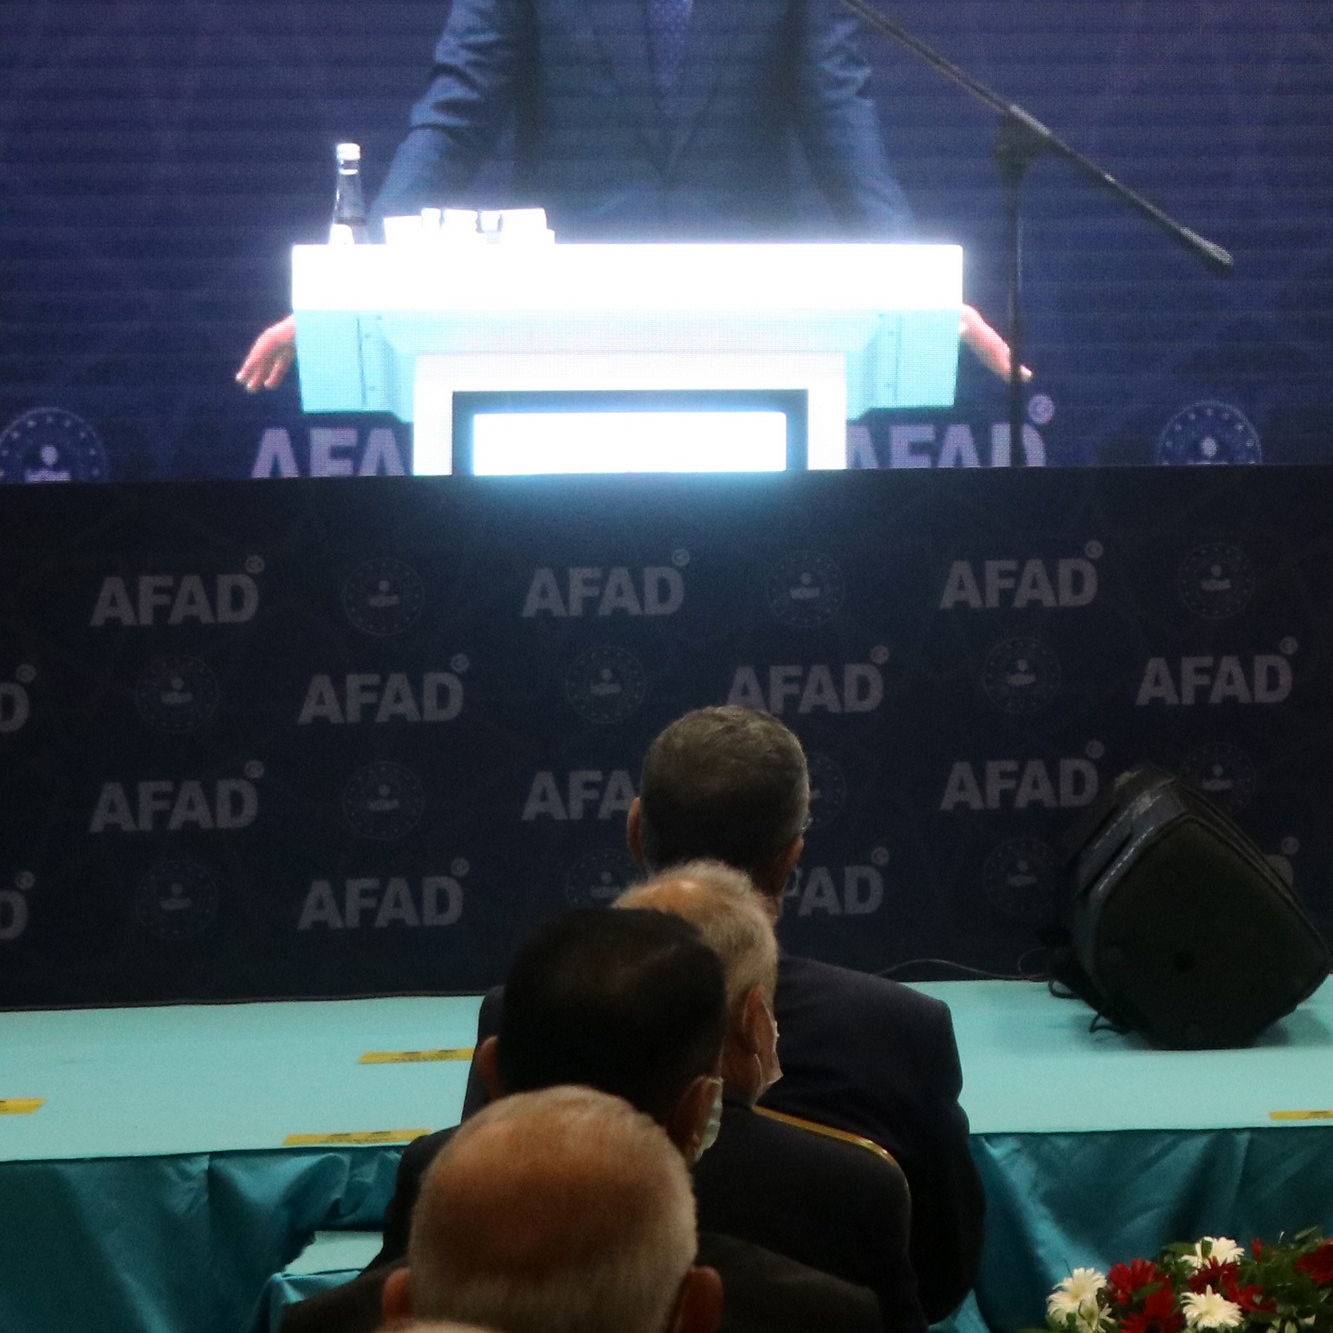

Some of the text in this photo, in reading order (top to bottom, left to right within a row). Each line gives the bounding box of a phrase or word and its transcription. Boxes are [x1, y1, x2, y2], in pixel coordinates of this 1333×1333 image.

[250, 427, 405, 478] AFA
[90, 573, 259, 627] AFAD
[522, 566, 685, 618] AFAD
[941, 557, 1098, 609] AFAD
[298, 673, 464, 725] AFAD
[727, 664, 884, 715] AFAD
[1137, 654, 1292, 706] AFAD
[89, 778, 258, 833] AFAD
[522, 771, 640, 822] AFA
[941, 758, 1098, 810] AFAD
[297, 878, 463, 931] AFAD
